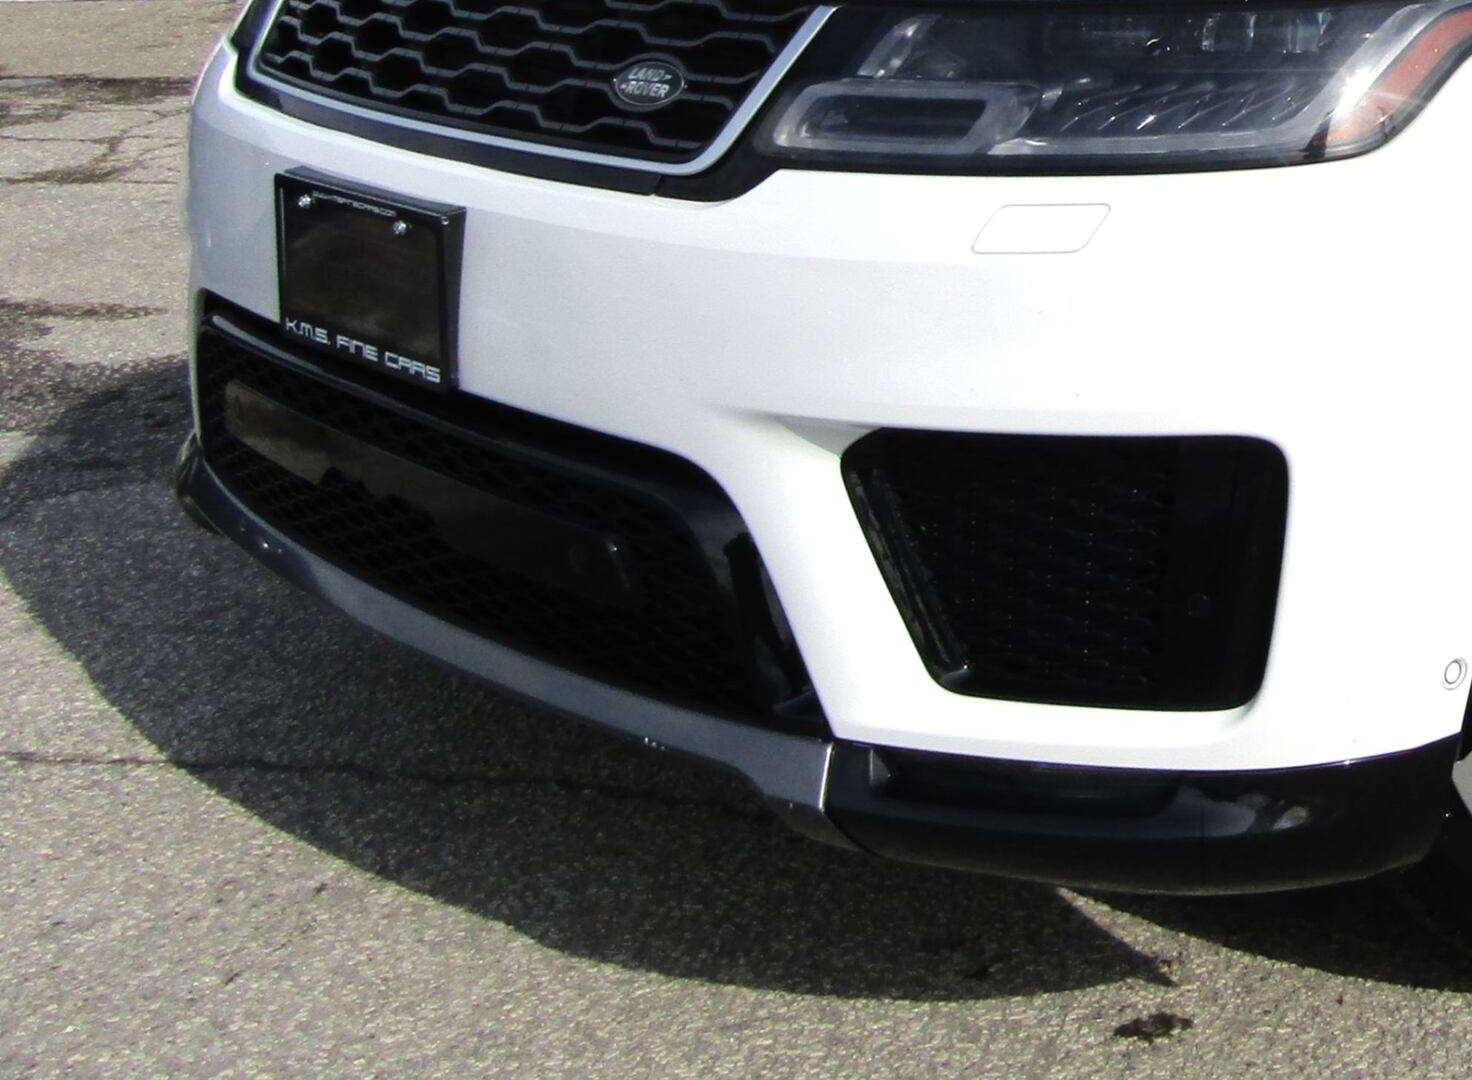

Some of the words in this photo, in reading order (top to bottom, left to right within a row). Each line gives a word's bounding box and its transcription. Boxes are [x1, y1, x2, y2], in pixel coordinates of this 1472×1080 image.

[628, 67, 666, 82] LAND
[624, 80, 671, 99] ROVER
[336, 334, 379, 362] FINE
[384, 351, 441, 384] CARS
